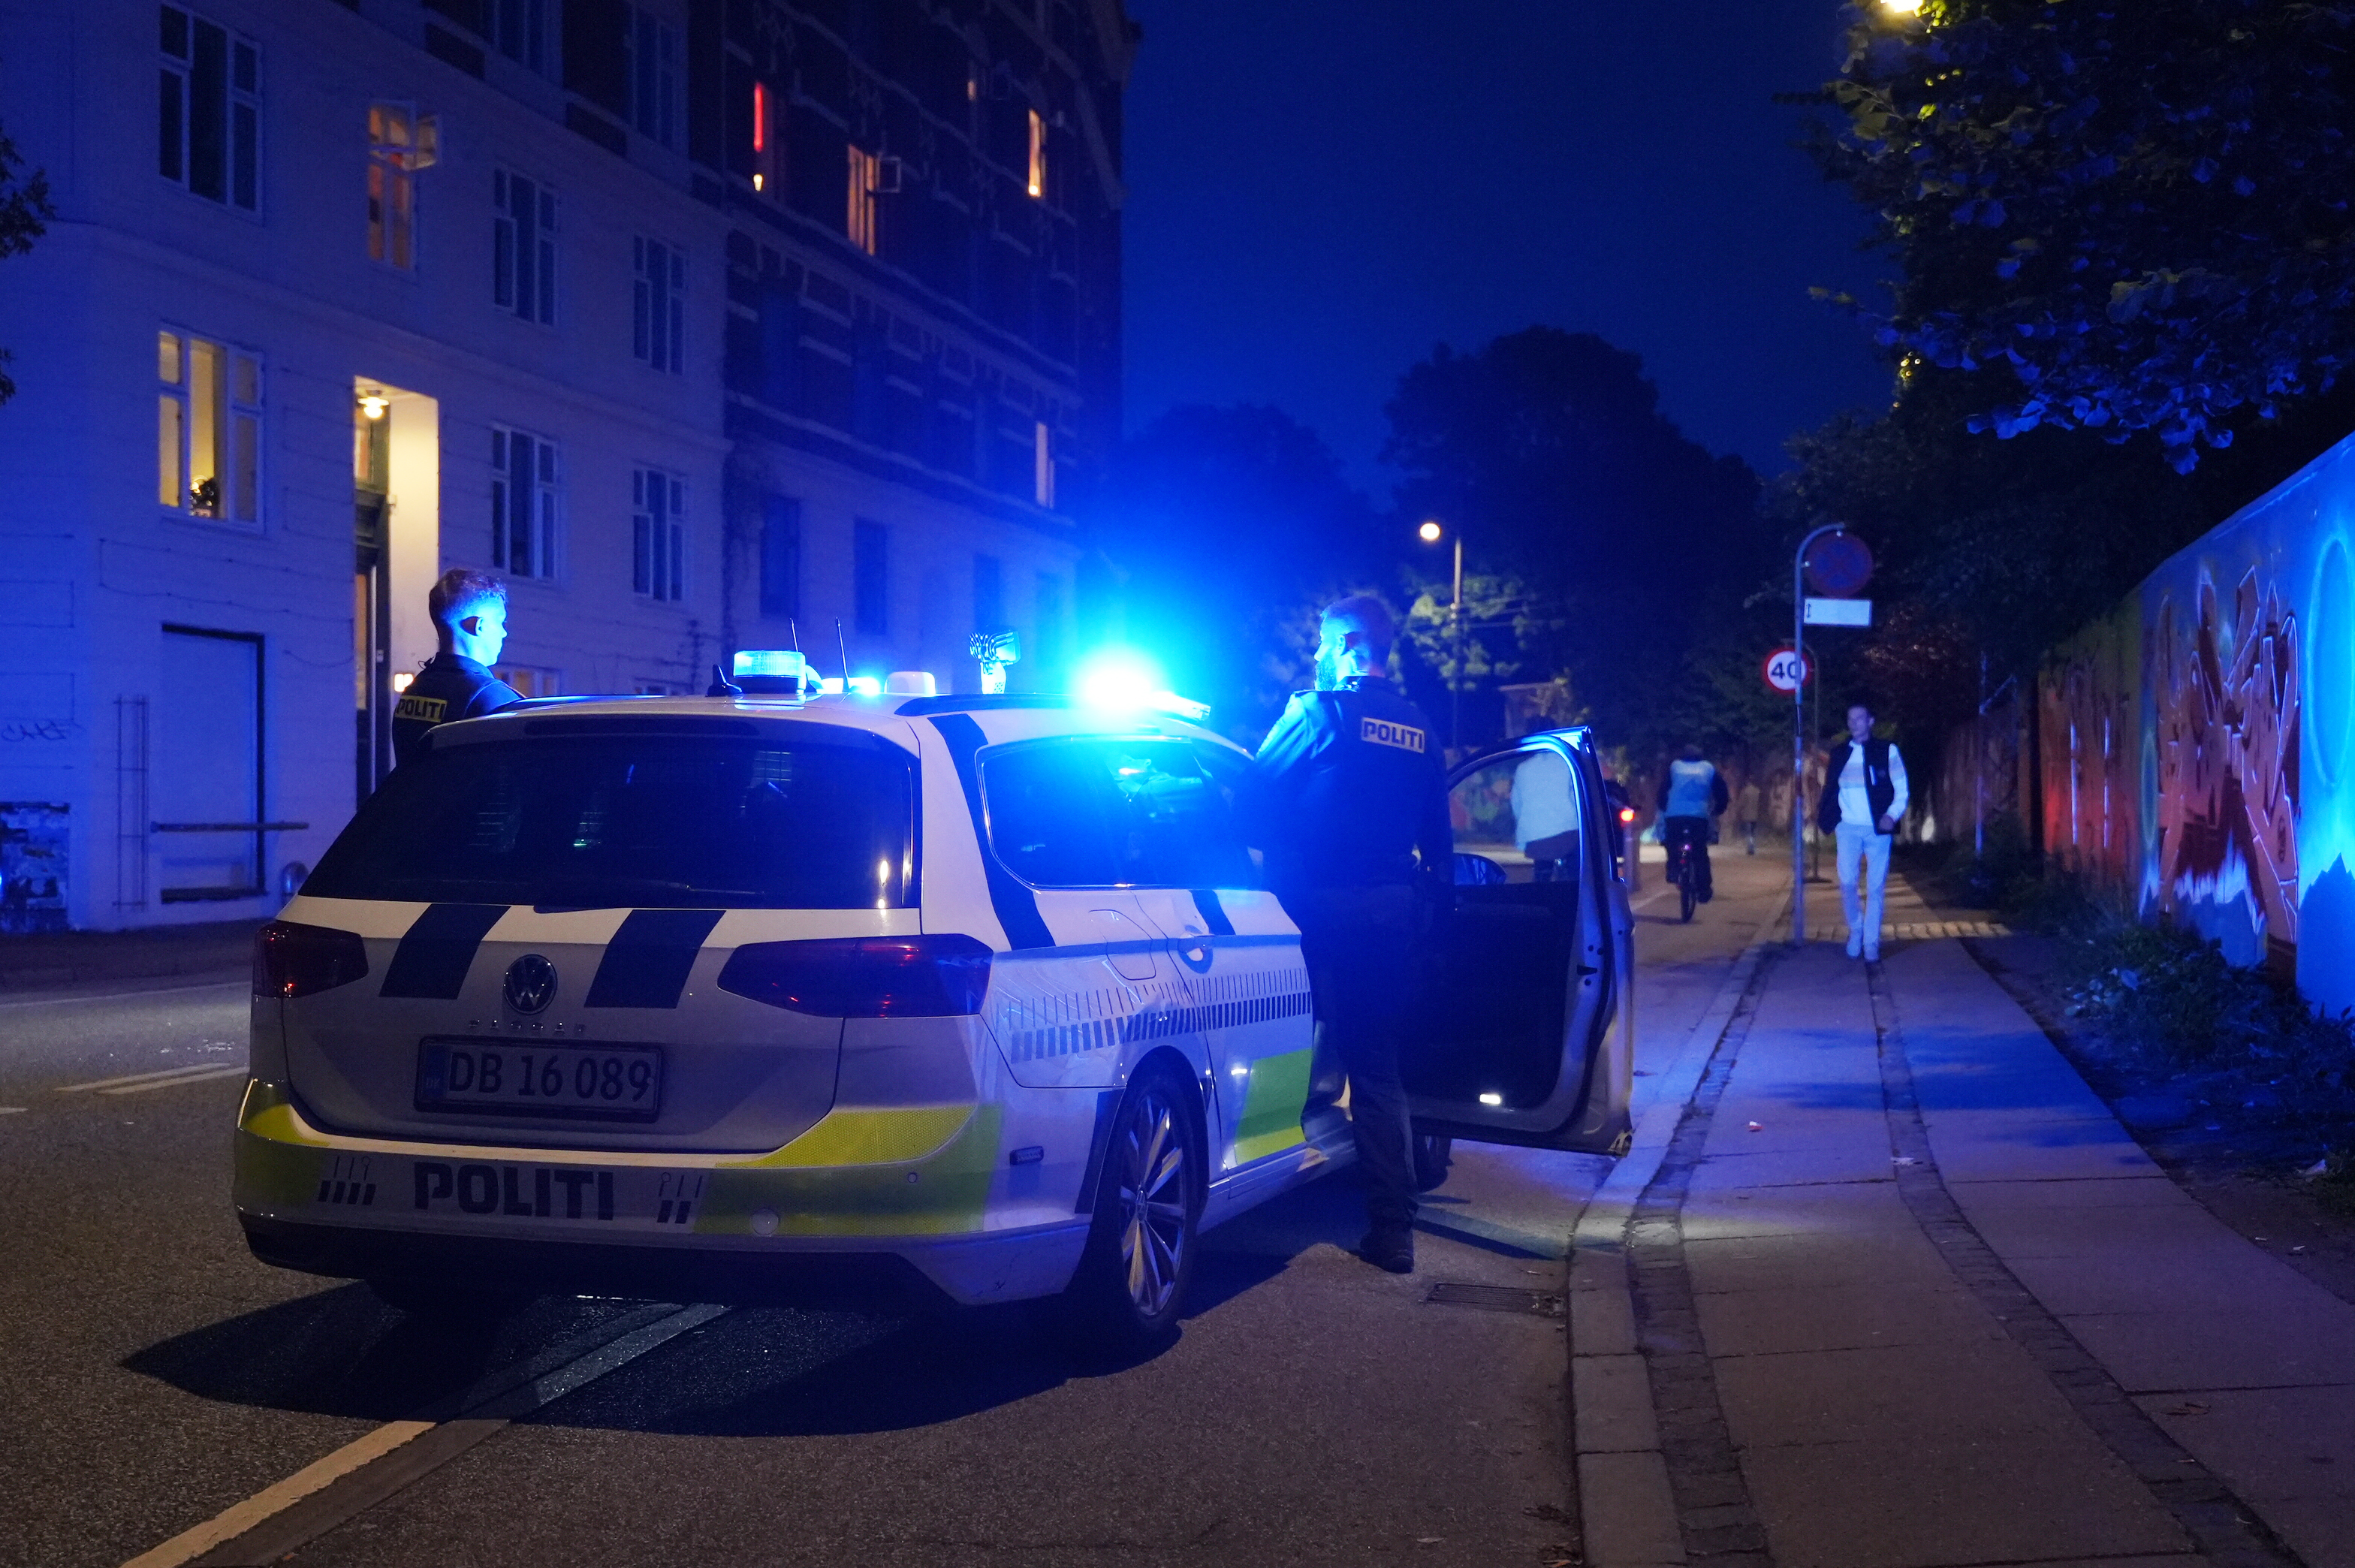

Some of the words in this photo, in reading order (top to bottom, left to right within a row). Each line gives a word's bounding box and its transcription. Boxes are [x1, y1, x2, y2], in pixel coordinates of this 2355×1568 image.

[1364, 721, 1422, 749] POLITI
[449, 1052, 502, 1093] DB
[517, 1054, 563, 1097] 16
[575, 1058, 652, 1102] 089
[414, 1162, 614, 1221] POLITI
